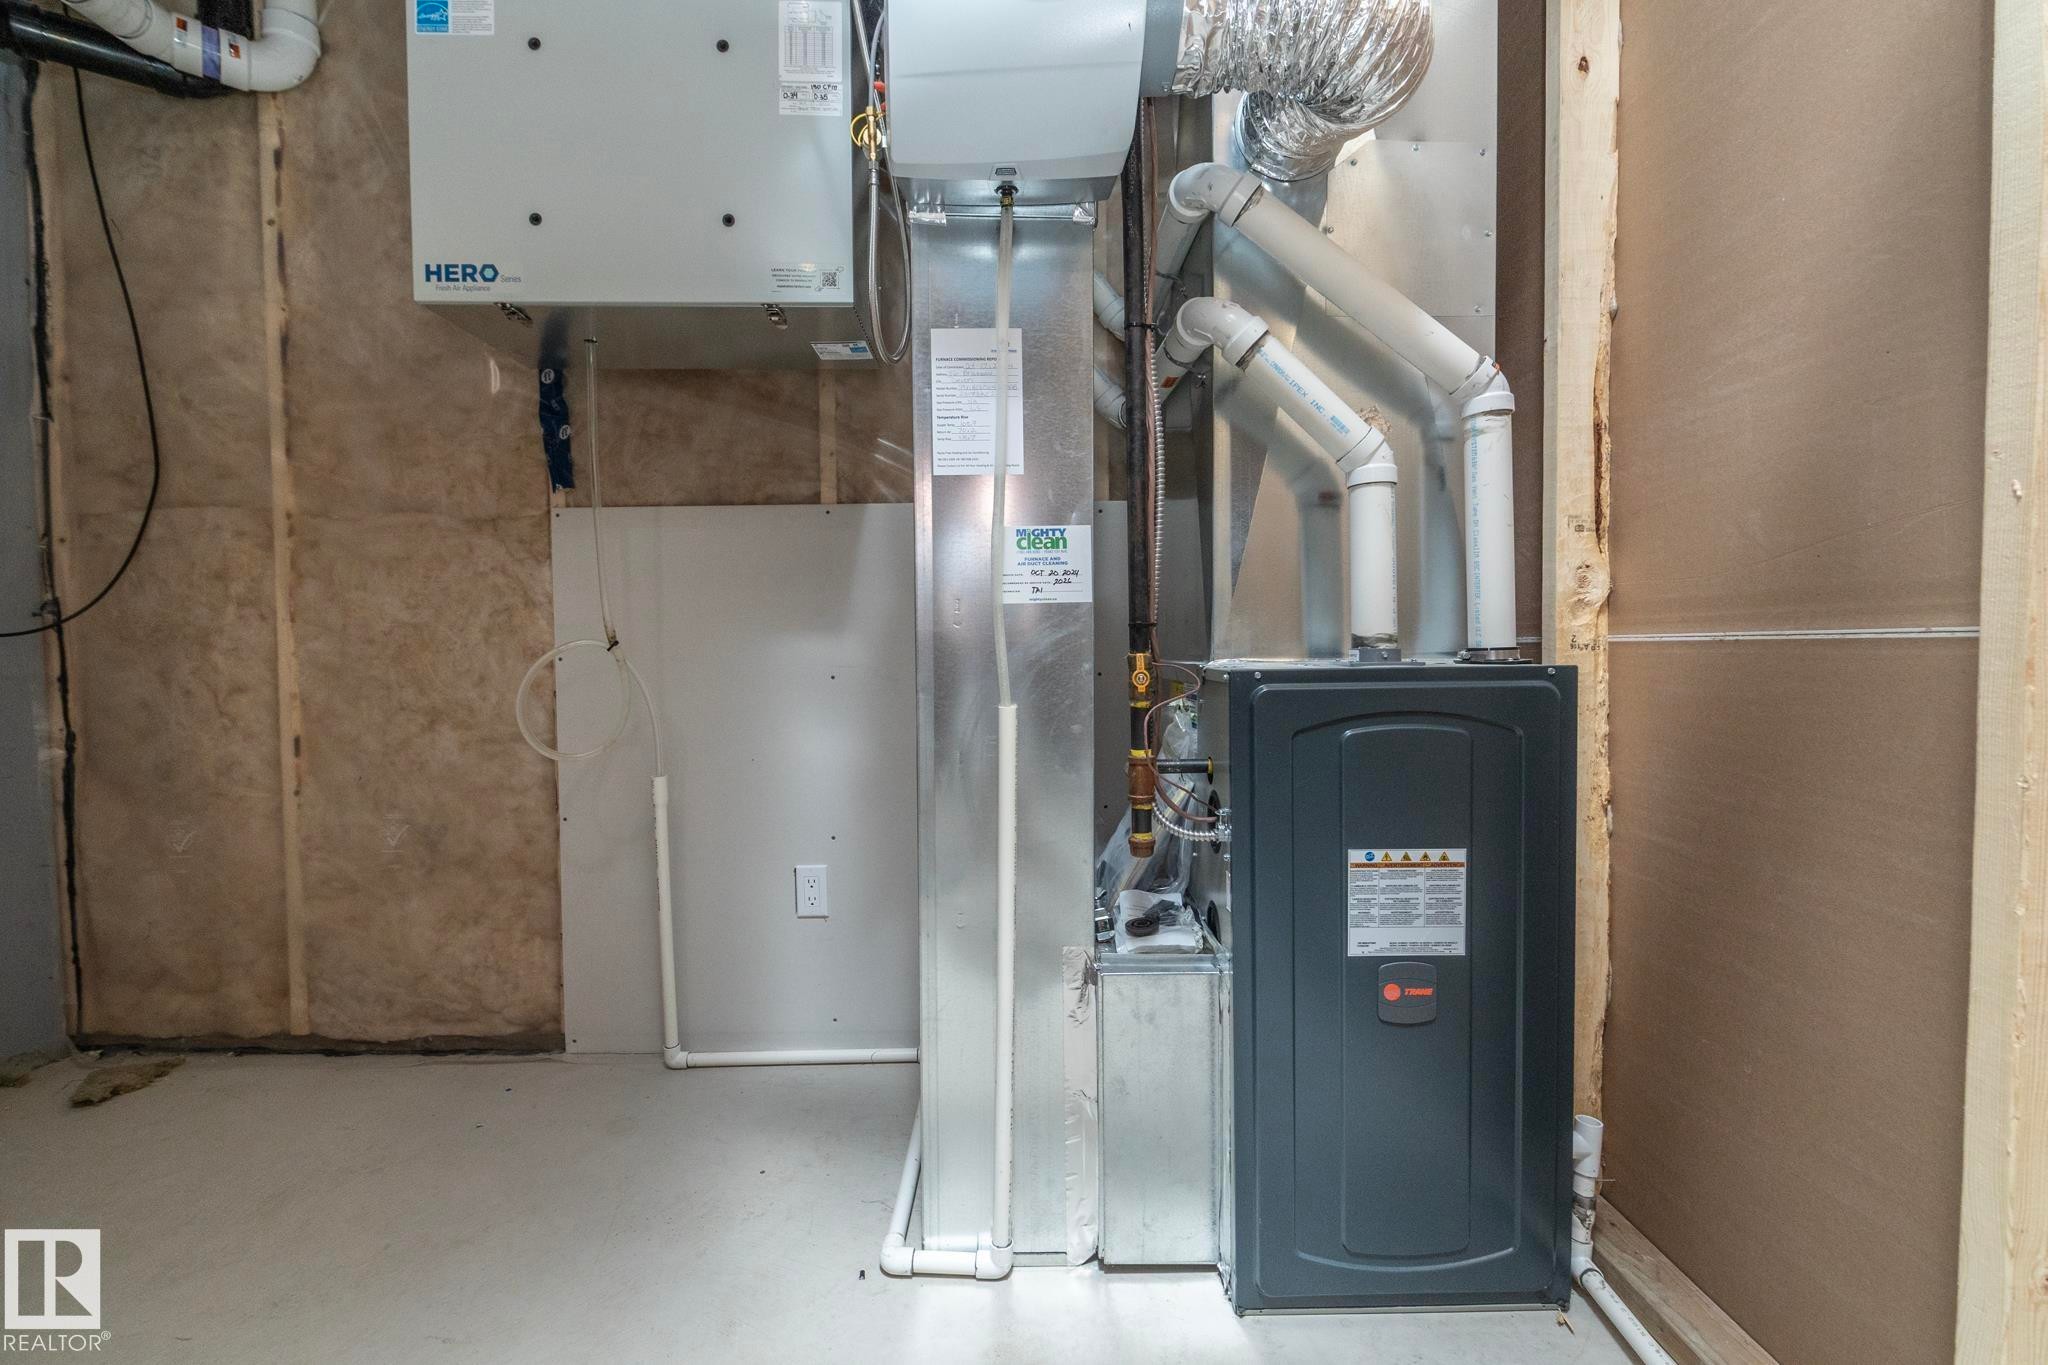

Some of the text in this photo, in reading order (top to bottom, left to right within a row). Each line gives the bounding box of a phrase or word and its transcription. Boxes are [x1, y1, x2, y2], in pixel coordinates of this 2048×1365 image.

[425, 263, 522, 283] HERO Series
[435, 284, 451, 292] Fresh
[462, 284, 491, 293] Appliance
[1016, 532, 1068, 550] clean
[1048, 569, 1059, 577] 20
[1062, 569, 1080, 577] 2024
[1404, 988, 1433, 996] TRANE
